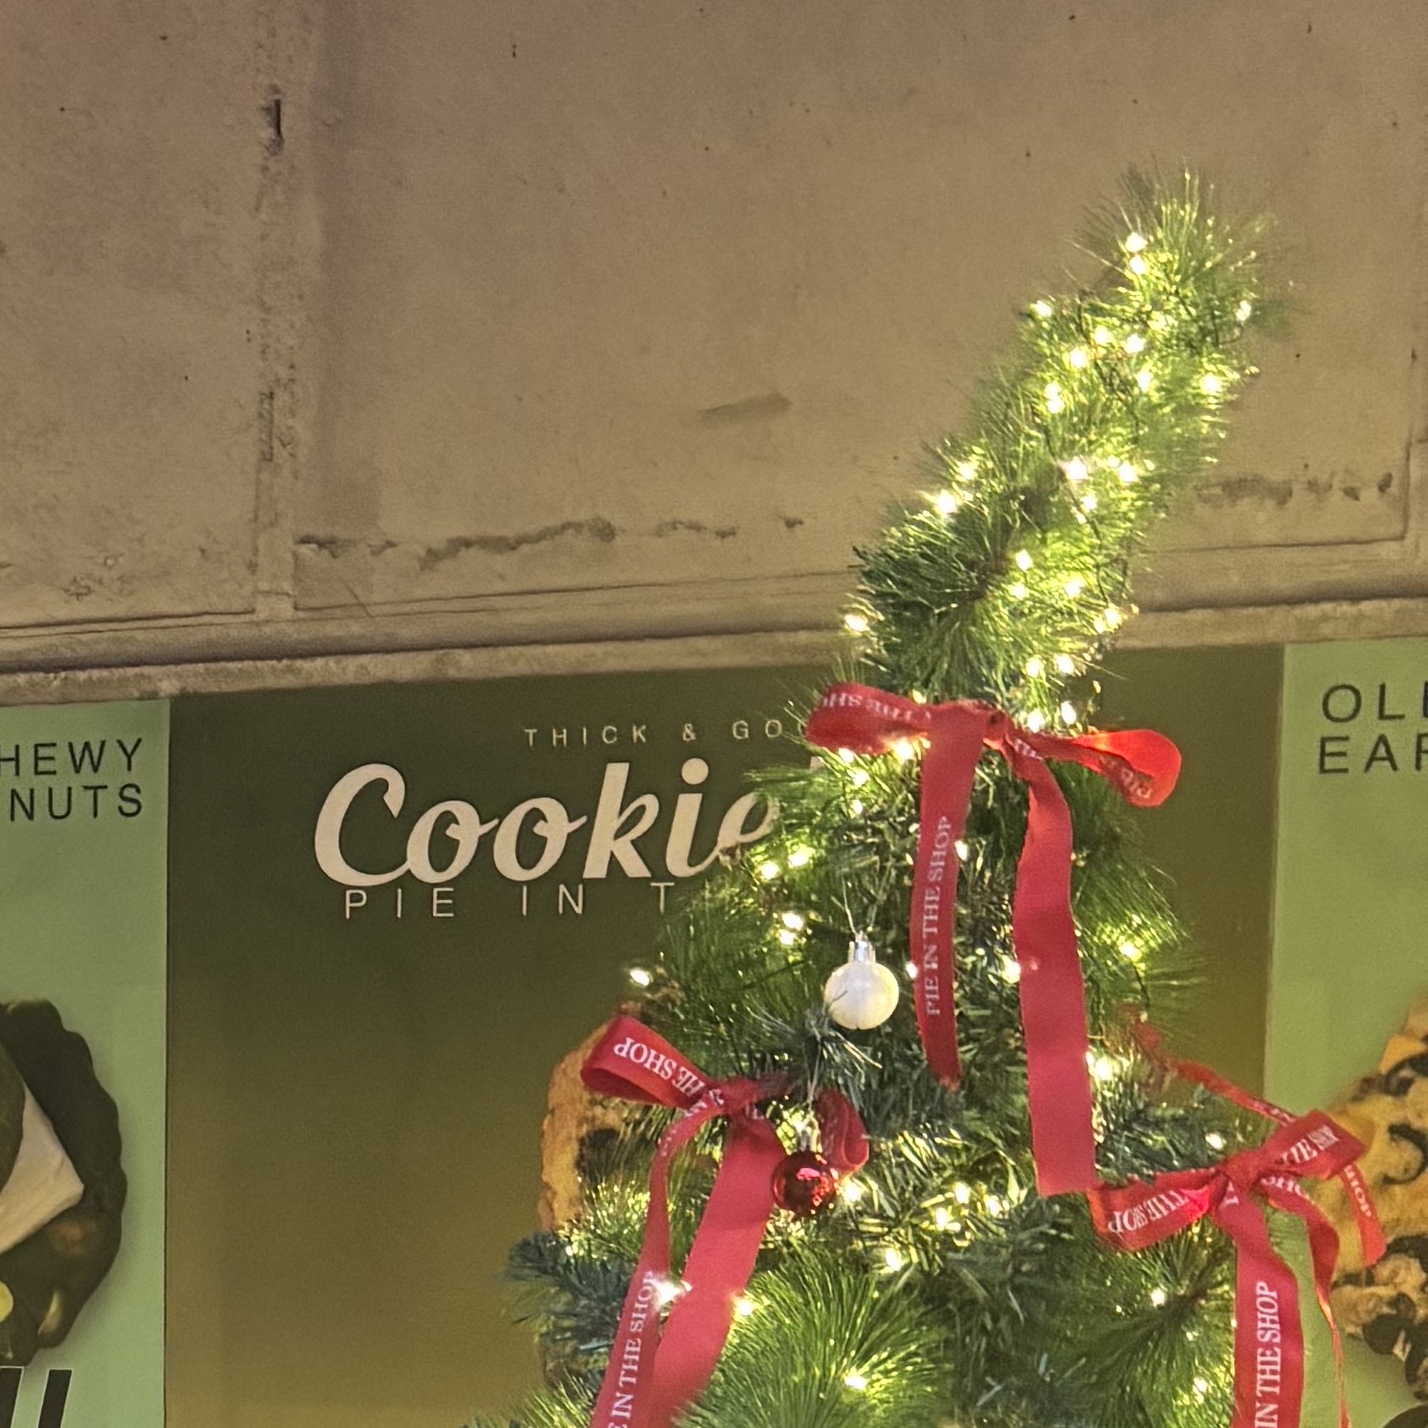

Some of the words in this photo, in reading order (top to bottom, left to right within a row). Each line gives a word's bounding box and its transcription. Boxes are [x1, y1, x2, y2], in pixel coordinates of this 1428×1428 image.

[524, 726, 647, 747] THICK
[10, 784, 144, 821] NUTS
[314, 757, 782, 886] Cookie
[929, 816, 952, 885] SHOP
[345, 888, 455, 919] PIE
[523, 884, 584, 917] IN
[923, 886, 940, 938] THE
[613, 1036, 679, 1083] SHOP
[630, 1270, 655, 1333] SHOP
[1256, 1281, 1281, 1343] SHOP
[618, 1335, 642, 1389] THE
[1256, 1343, 1281, 1400] THE
[607, 1395, 634, 1423] IN
